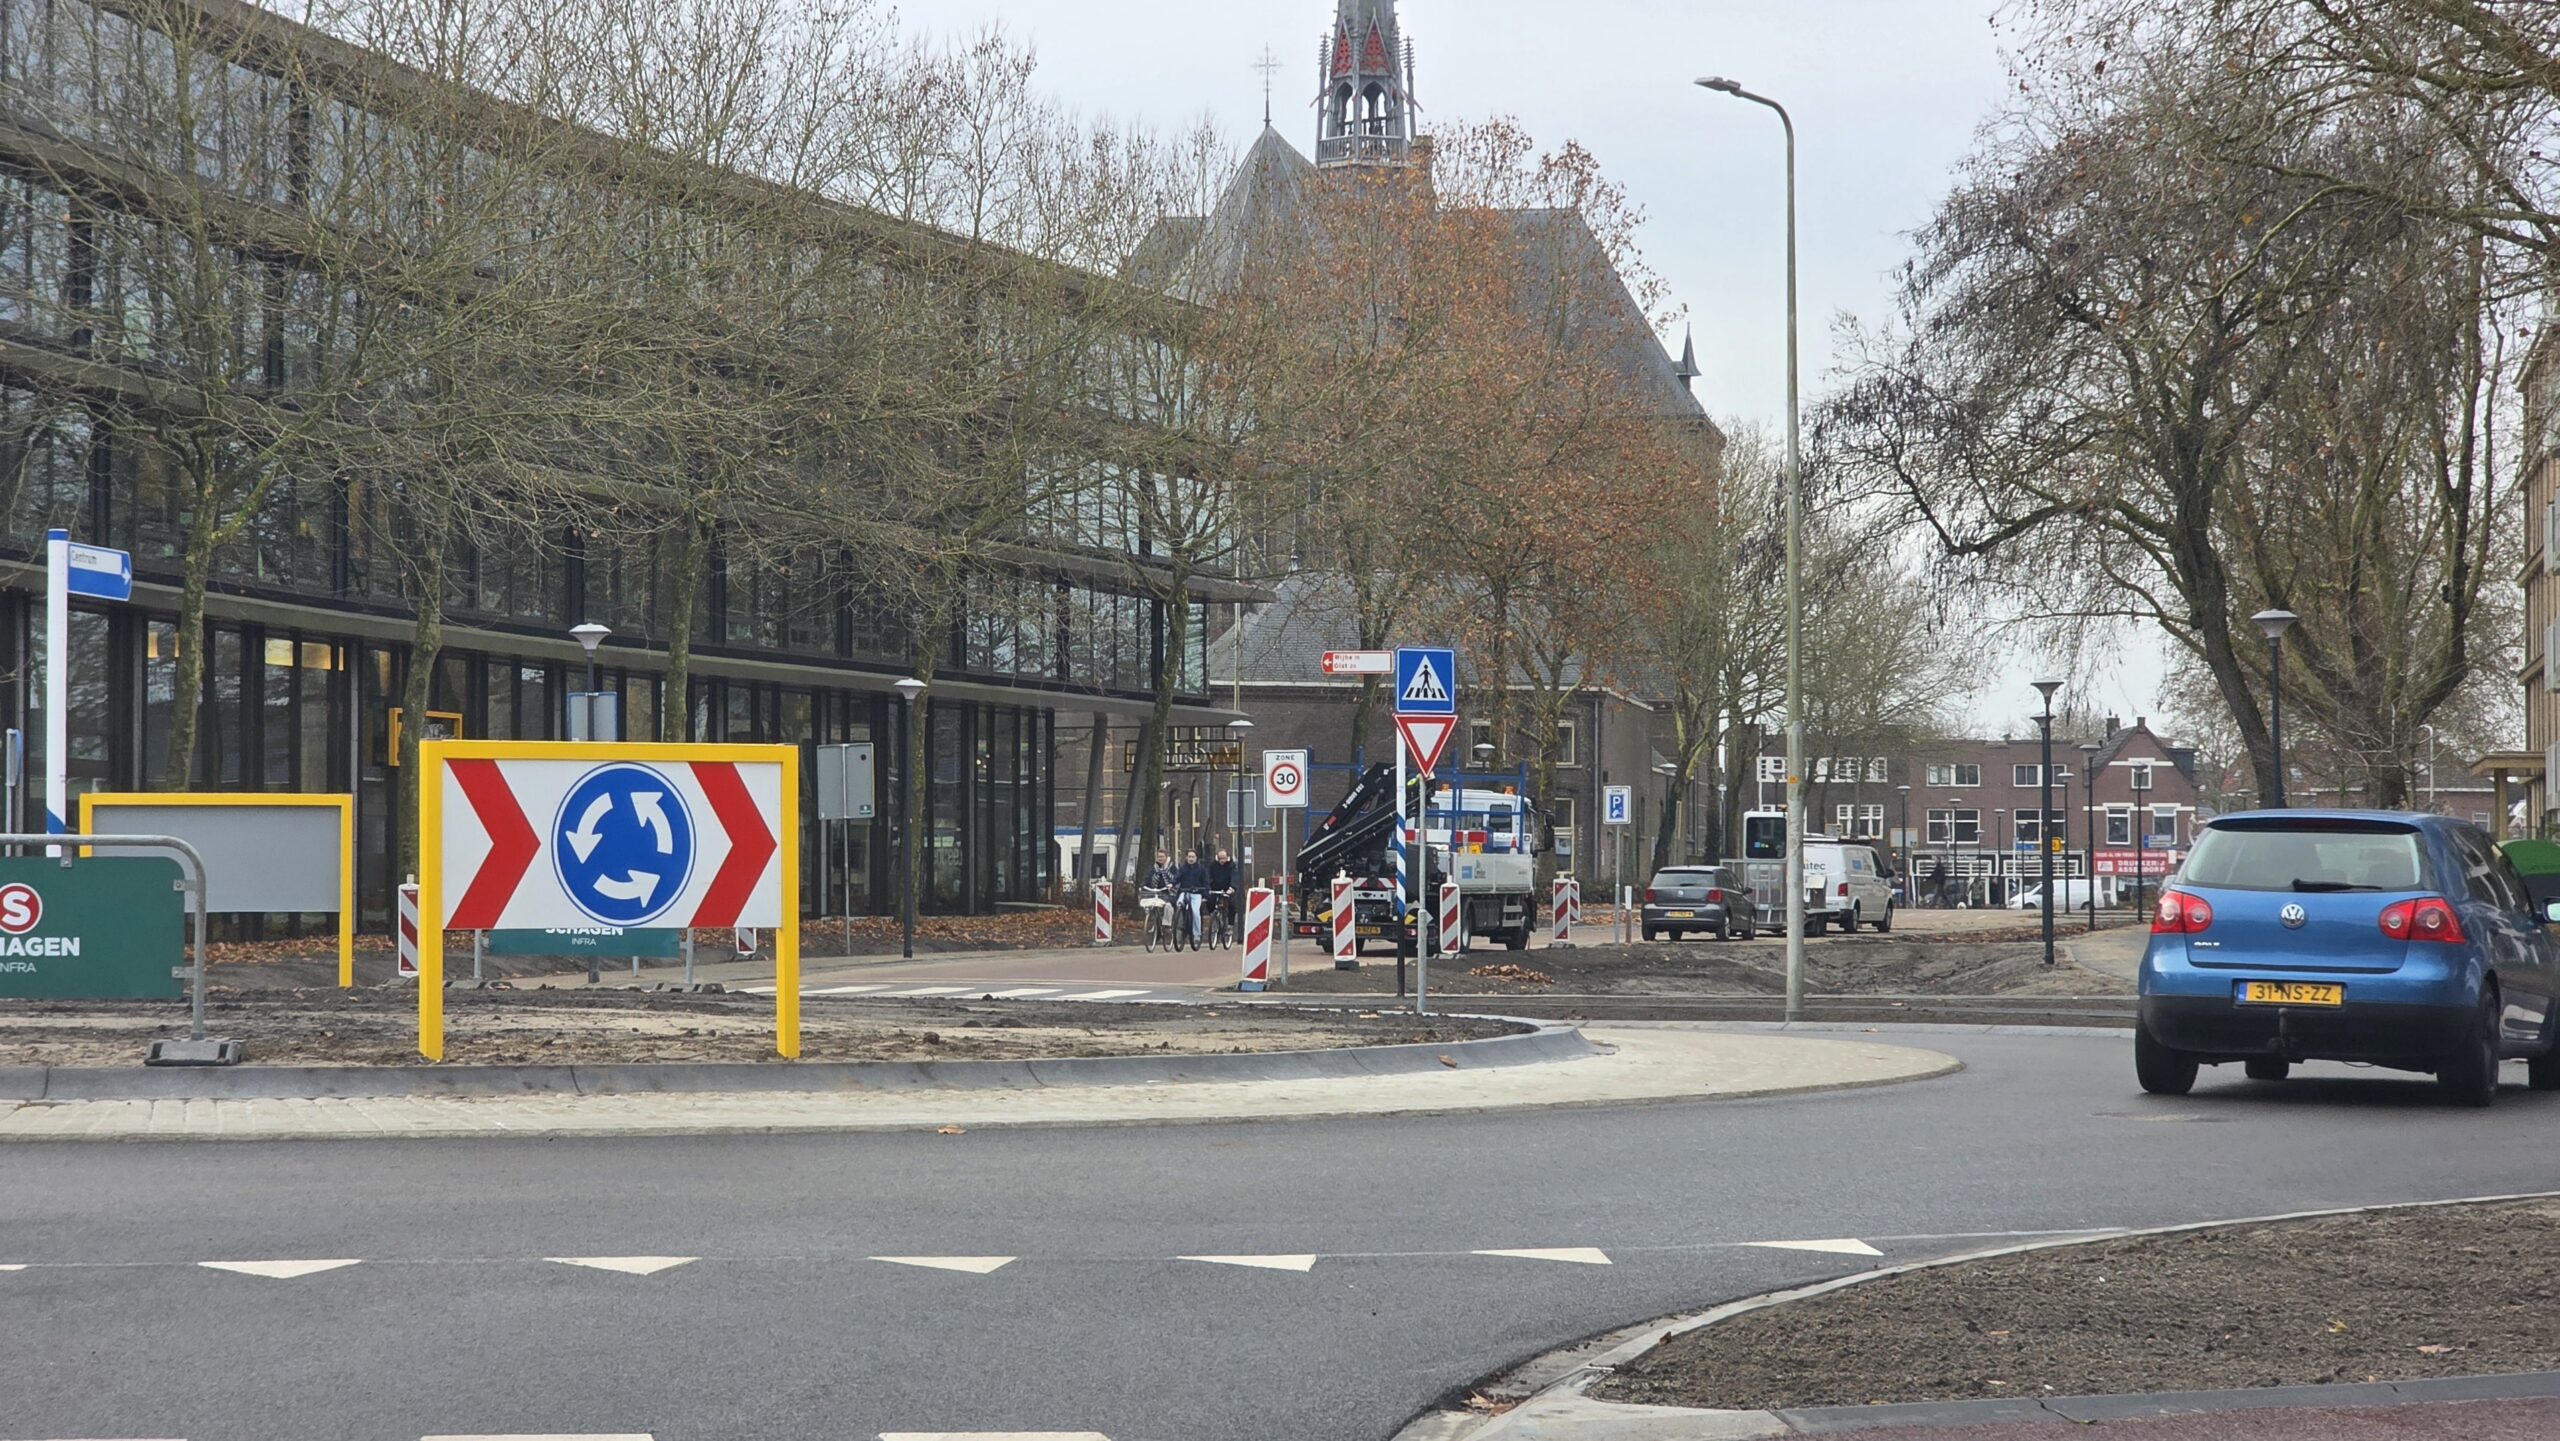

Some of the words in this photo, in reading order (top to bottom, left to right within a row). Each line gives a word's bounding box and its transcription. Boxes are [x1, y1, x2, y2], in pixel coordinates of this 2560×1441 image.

[1276, 773, 1296, 785] 30
[1612, 796, 1622, 809] P
[2, 890, 31, 926] S
[0, 937, 80, 957] AGEN
[571, 937, 597, 946] INFRA
[2255, 984, 2332, 1002] 31-NS-ZZ
